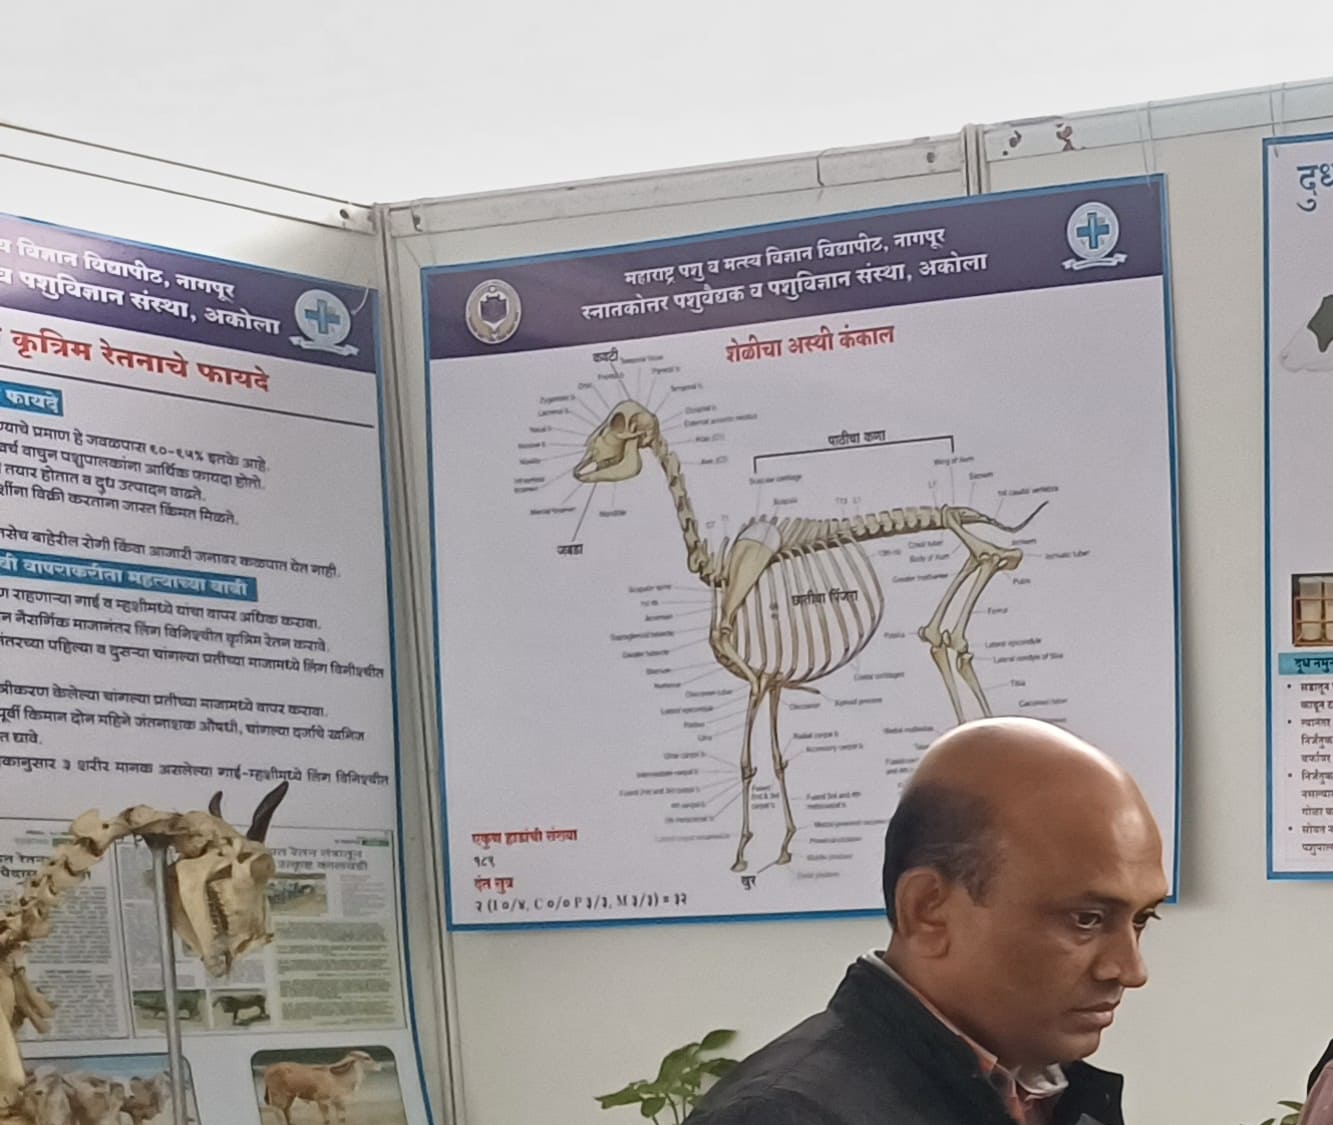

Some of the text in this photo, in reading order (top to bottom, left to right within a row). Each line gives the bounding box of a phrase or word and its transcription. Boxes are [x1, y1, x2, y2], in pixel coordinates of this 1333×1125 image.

[17, 238, 234, 300] विज्ञान विद्यापीठ, नागपूर
[624, 266, 674, 284] महाराष्ट्र
[678, 263, 704, 281] पशु
[707, 260, 719, 272] व
[723, 254, 762, 270] मत्स्य
[766, 246, 812, 265] विज्ञान
[894, 229, 944, 249] नागपूर
[19, 271, 280, 334] पशुविज्ञान संस्था, अकोला
[582, 253, 987, 319] स्नातकोत्तर पशुवैद्यक व पशुविज्ञान संस्था, अकोला
[10, 330, 270, 392] कृत्रिम रेतनाचे फायदे
[726, 326, 894, 362] शेळीचा अस्थी कंकाल
[6, 390, 58, 413] फायदे
[32, 426, 70, 441] प्रमाण
[72, 428, 83, 446] हे
[86, 434, 146, 452] जवळपास
[4, 464, 37, 482] तयार
[40, 467, 79, 484] होतात
[82, 475, 92, 485] व
[118, 480, 167, 496] उत्पादन
[1294, 658, 1314, 673] दूध
